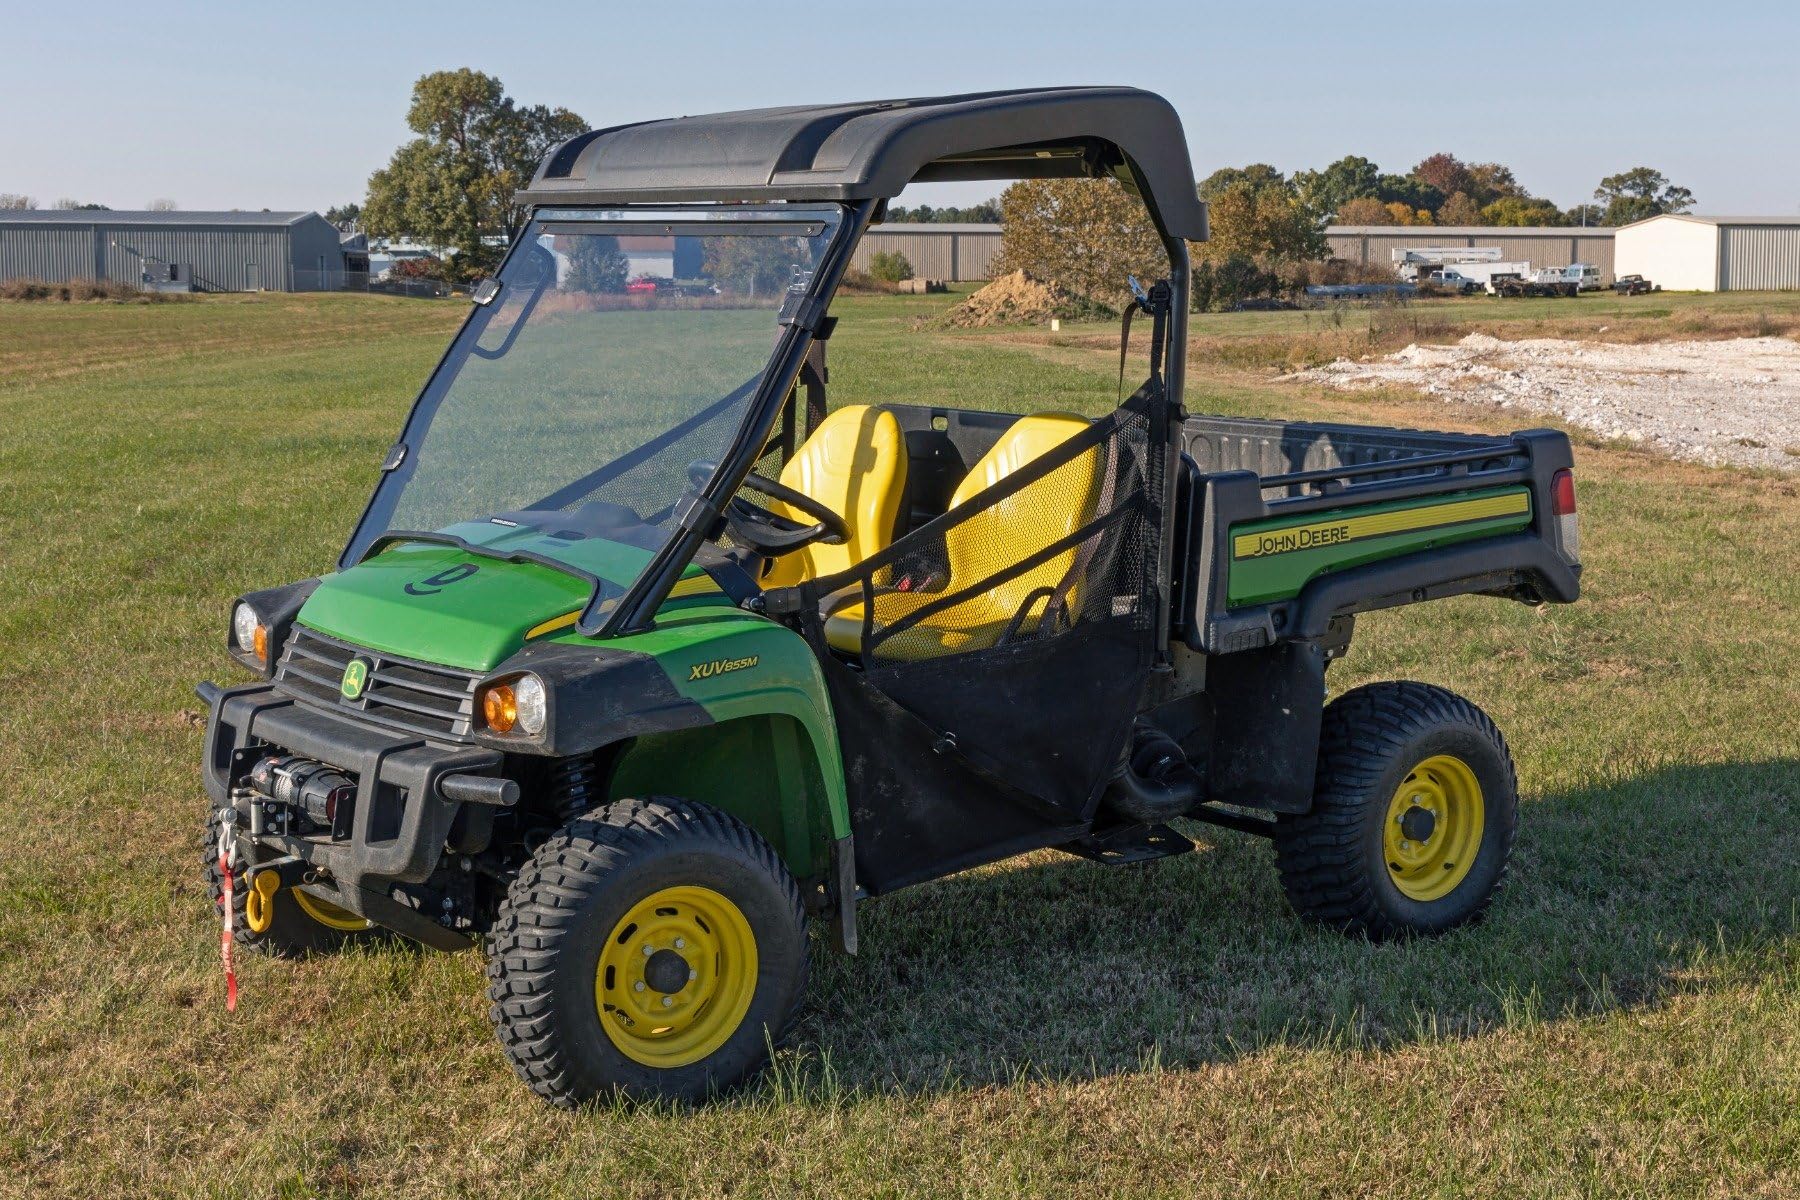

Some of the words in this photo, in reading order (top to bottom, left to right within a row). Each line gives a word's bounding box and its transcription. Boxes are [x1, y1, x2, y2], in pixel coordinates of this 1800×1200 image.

[1254, 534, 1296, 554] JOHN
[1299, 525, 1349, 547] DEERE
[688, 655, 759, 681] XUV855M
